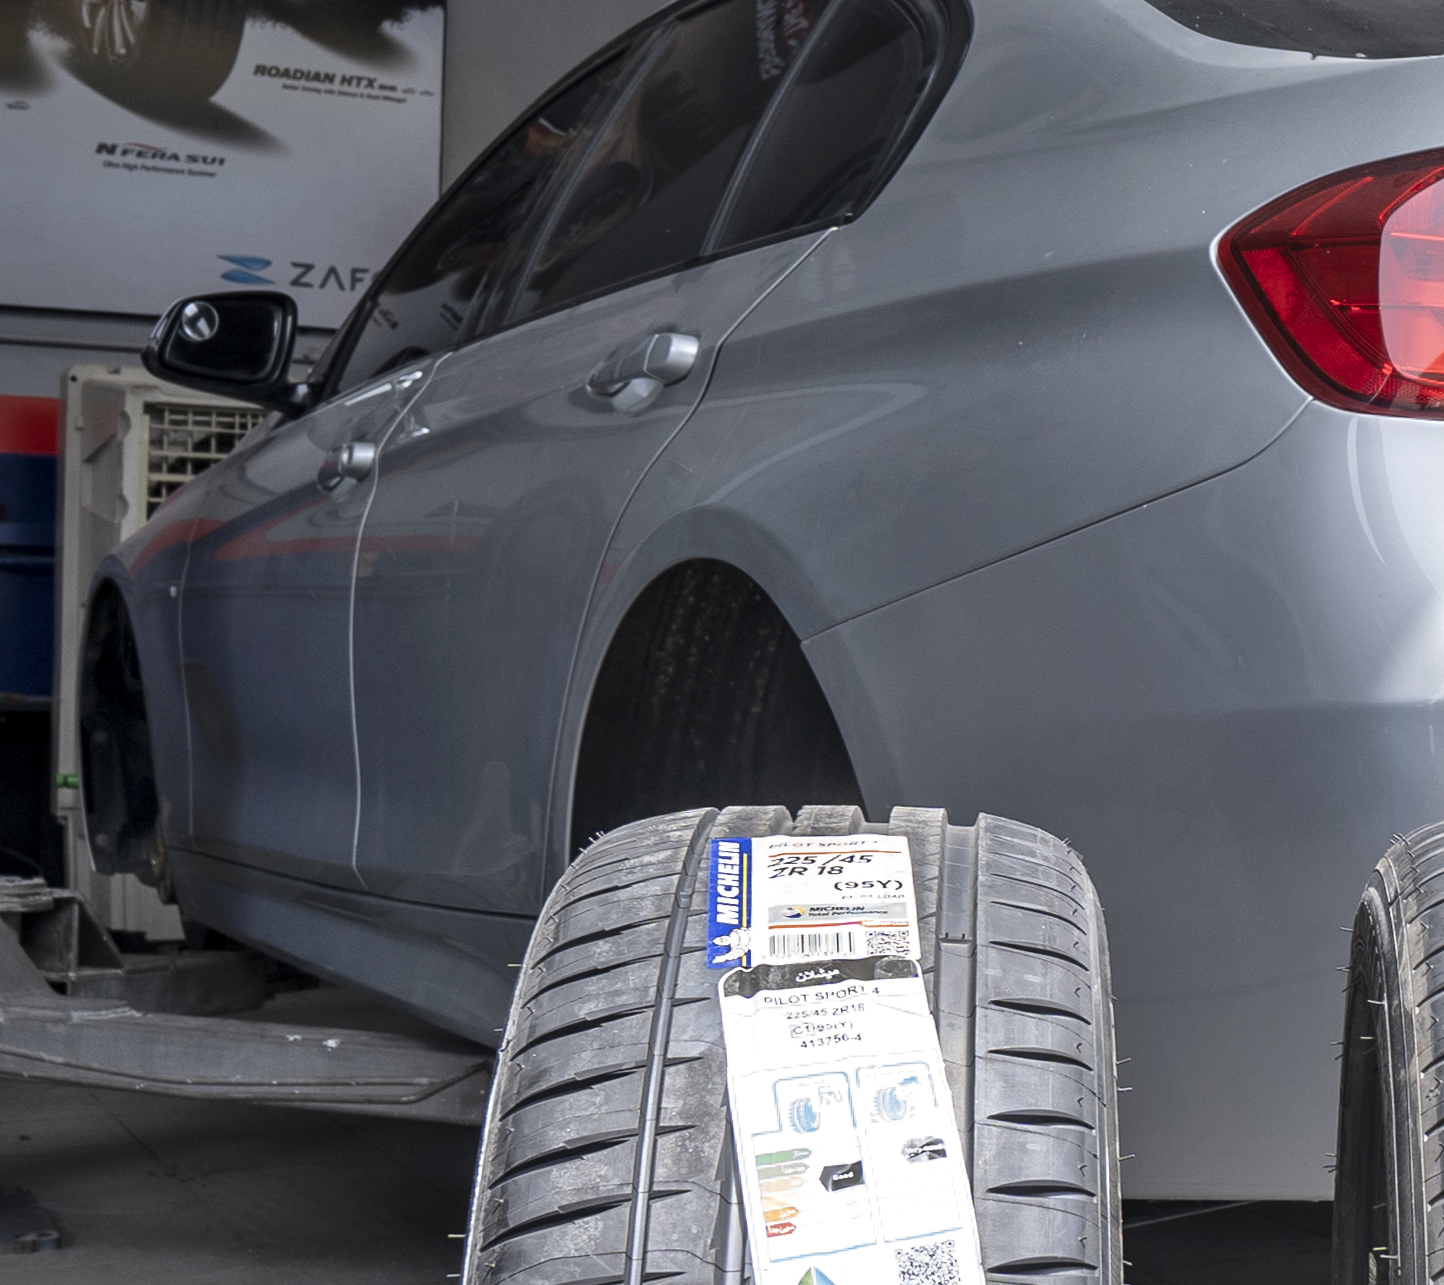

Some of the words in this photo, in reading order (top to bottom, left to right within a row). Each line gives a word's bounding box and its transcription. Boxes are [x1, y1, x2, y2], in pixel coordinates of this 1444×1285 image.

[253, 64, 336, 85] ROADIAN
[340, 73, 377, 89] HTX
[288, 260, 380, 293] ZAF
[768, 866, 808, 879] ZR
[817, 865, 844, 876] 18
[716, 841, 740, 925] MICHELIN
[834, 879, 903, 891] (95Y)
[796, 967, 840, 983] ميشلان
[764, 993, 810, 1005] PILOT
[815, 985, 865, 1000] SPORT
[872, 986, 880, 995] 4
[800, 1033, 862, 1048] 413756-4
